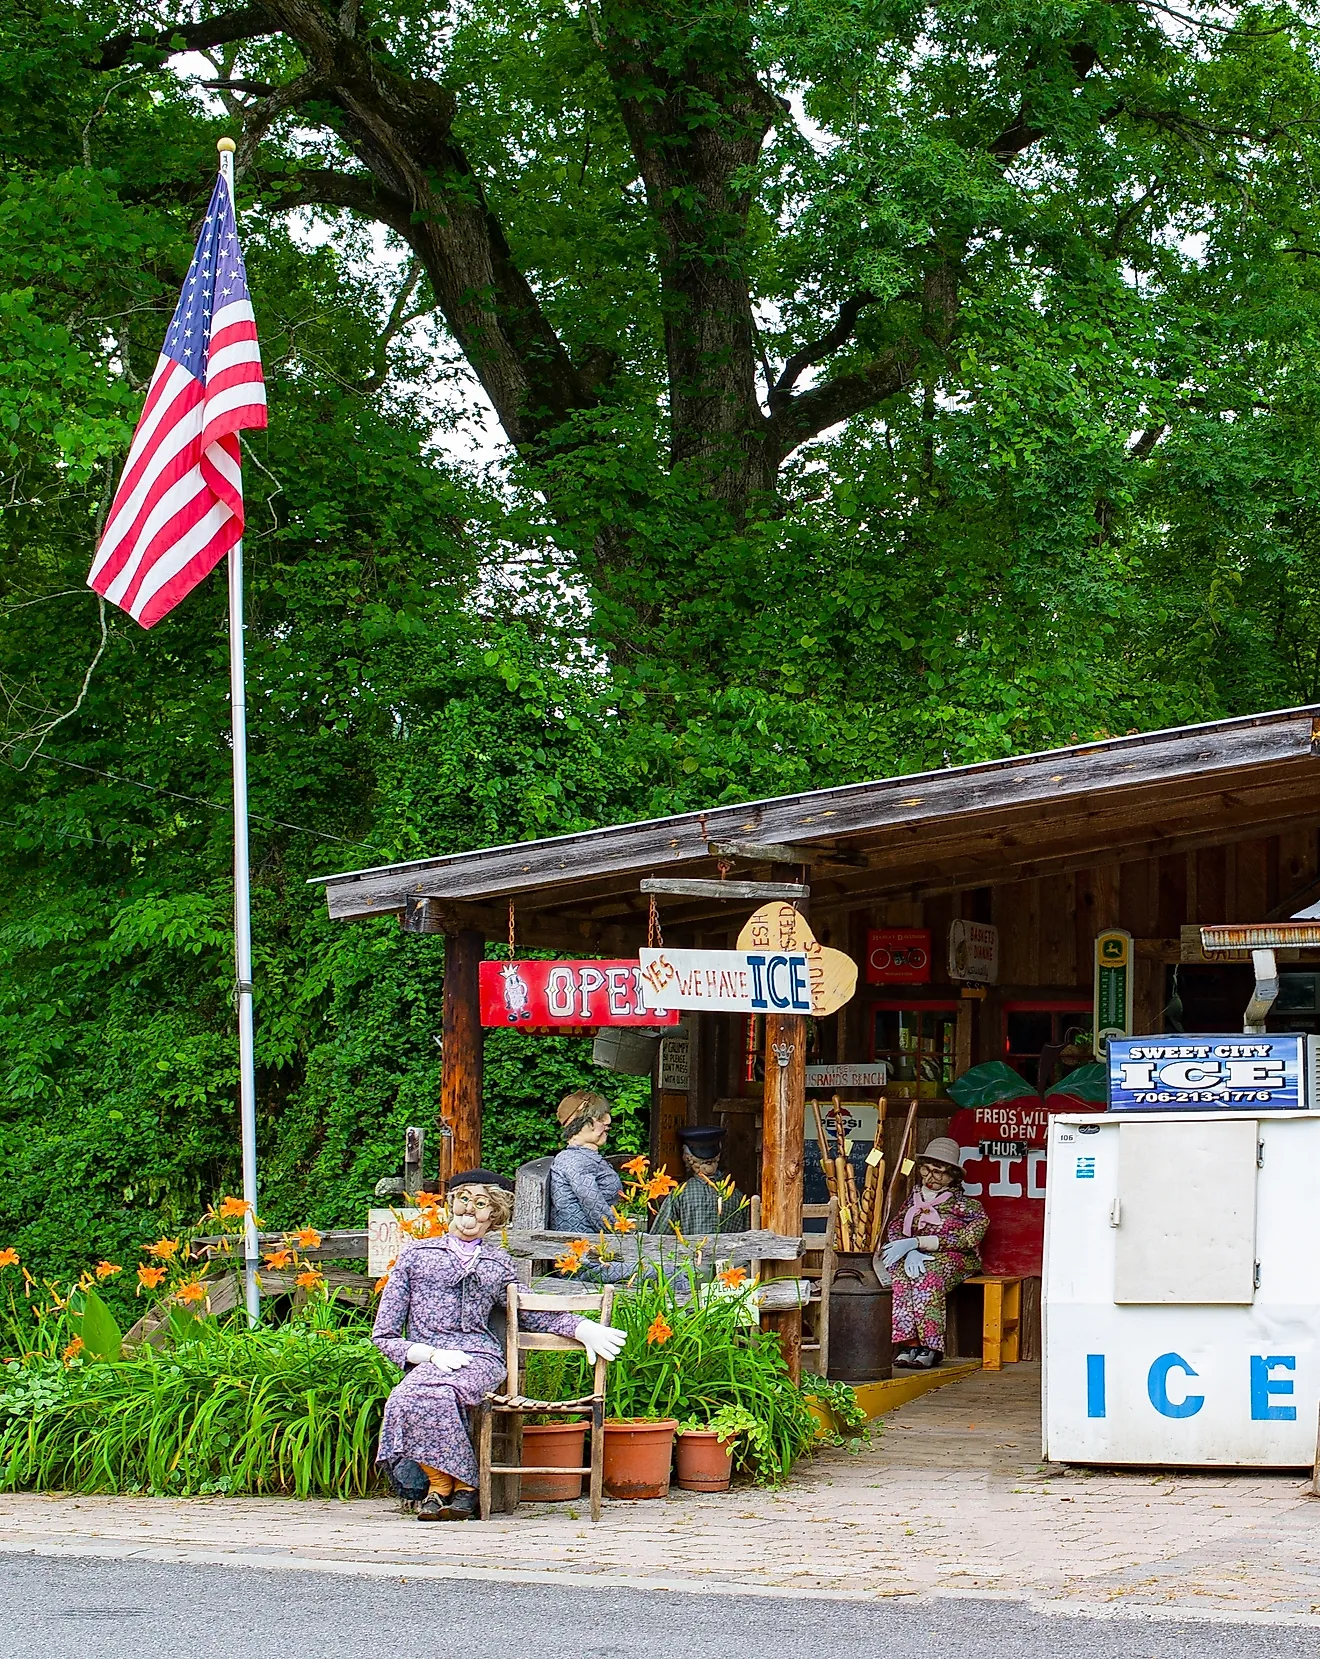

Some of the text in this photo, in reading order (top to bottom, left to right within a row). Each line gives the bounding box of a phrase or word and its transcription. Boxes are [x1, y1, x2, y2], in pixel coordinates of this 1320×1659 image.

[751, 913, 770, 950] ESH
[642, 954, 675, 994] YES
[676, 956, 810, 1009] WE HAVE ICE
[1129, 1044, 1272, 1060] SWEET CITY
[805, 1072, 849, 1087] USBANDS
[1120, 1060, 1287, 1092] ICE
[1133, 1090, 1271, 1105] 706-213-1776
[976, 1108, 1049, 1125] FRED'S WIL
[1000, 1125, 1036, 1139] OPEN
[981, 1141, 1023, 1157] THUR.
[369, 1220, 400, 1243] SOR
[1086, 1351, 1297, 1421] ICE
